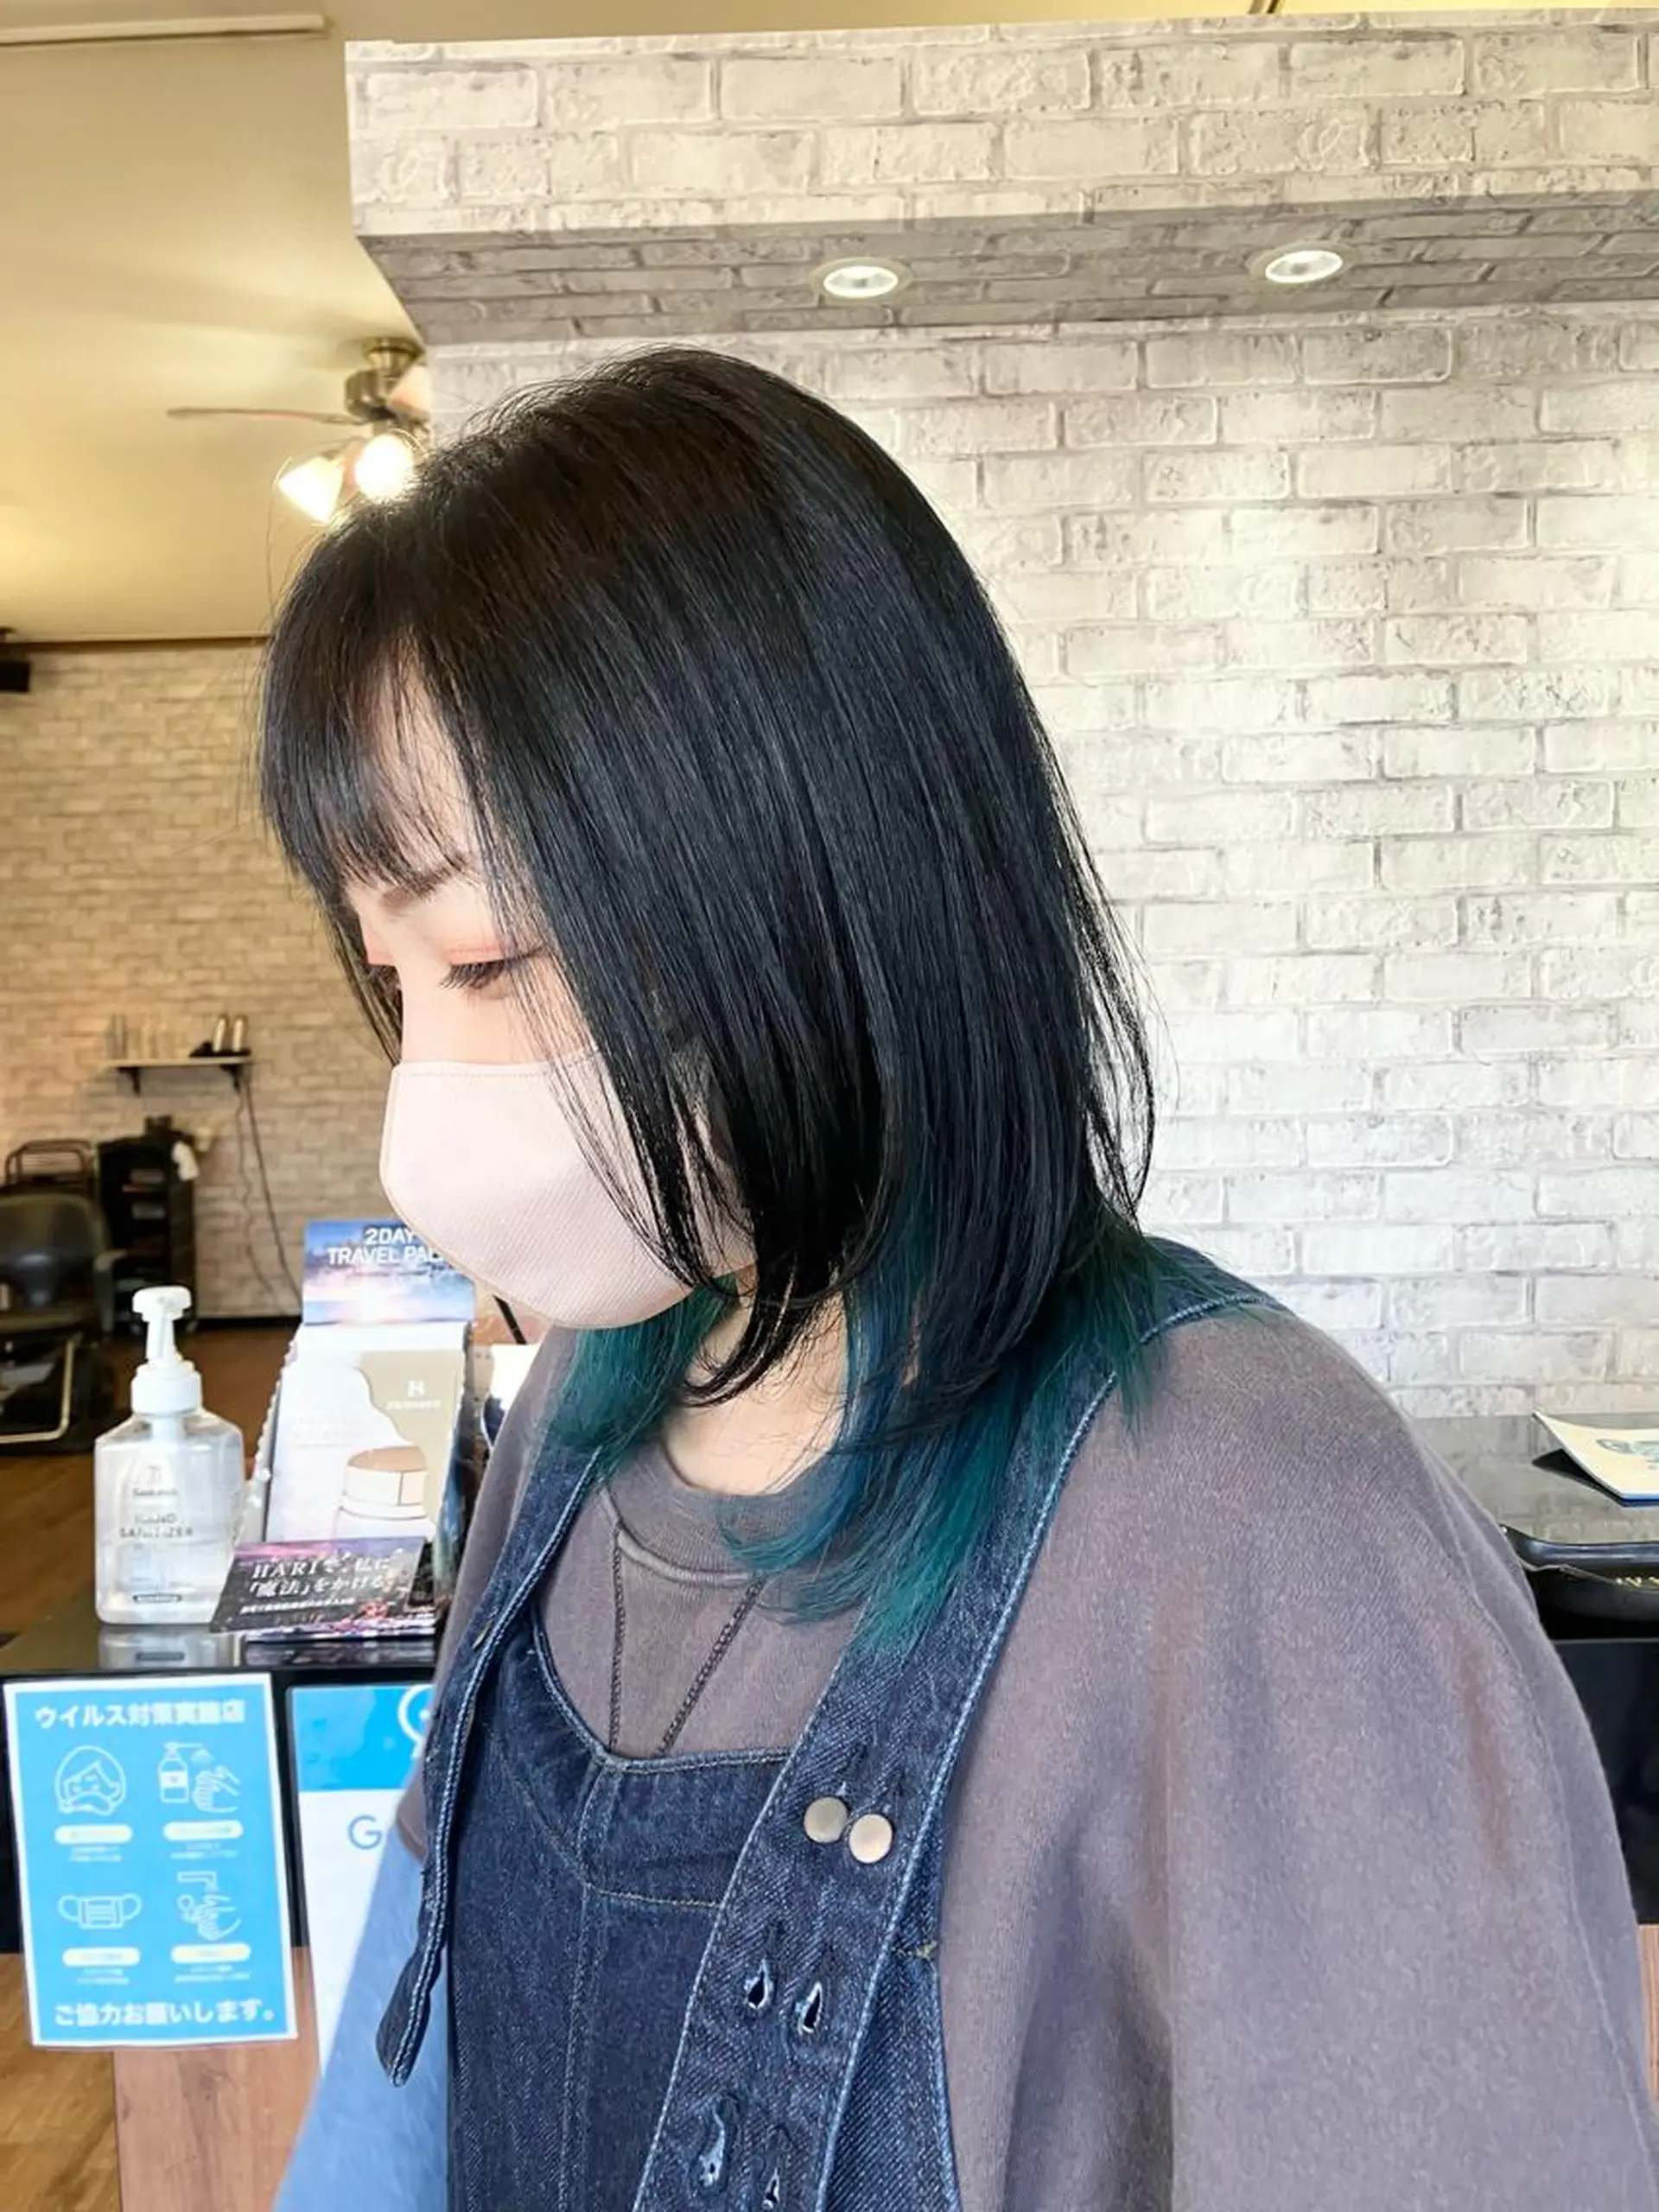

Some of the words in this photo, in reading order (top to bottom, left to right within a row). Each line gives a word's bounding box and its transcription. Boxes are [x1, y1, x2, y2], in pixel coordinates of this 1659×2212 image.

[327, 1246, 401, 1265] TRAVEL
[54, 1998, 276, 2027] ご協力お願いします。
